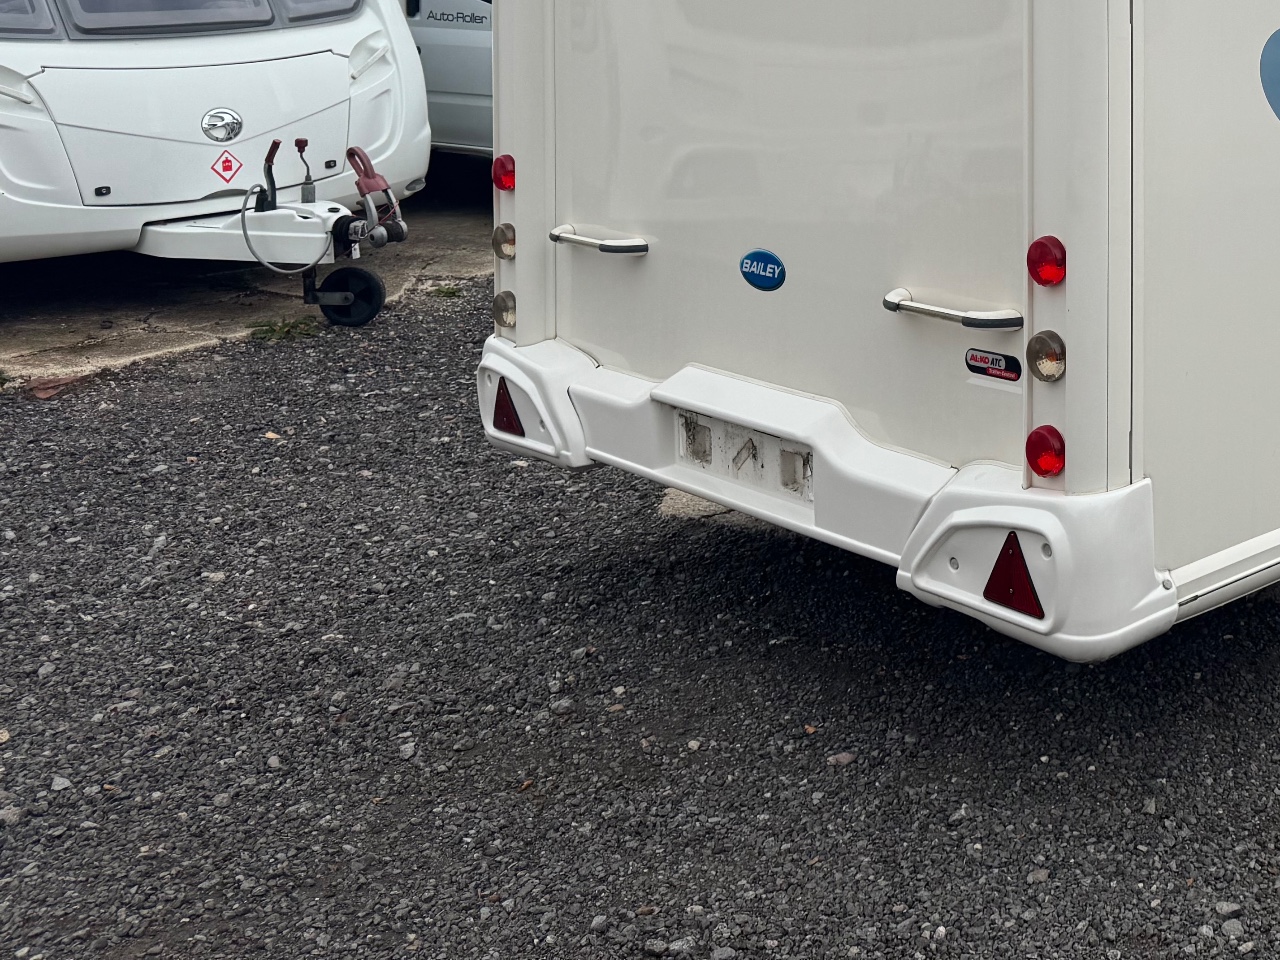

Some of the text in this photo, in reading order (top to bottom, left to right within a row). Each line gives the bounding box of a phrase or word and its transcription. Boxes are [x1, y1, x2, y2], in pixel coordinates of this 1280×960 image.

[427, 10, 487, 24] Auto-Roller
[742, 259, 782, 278] BAILEY
[990, 357, 1003, 368] ATC
